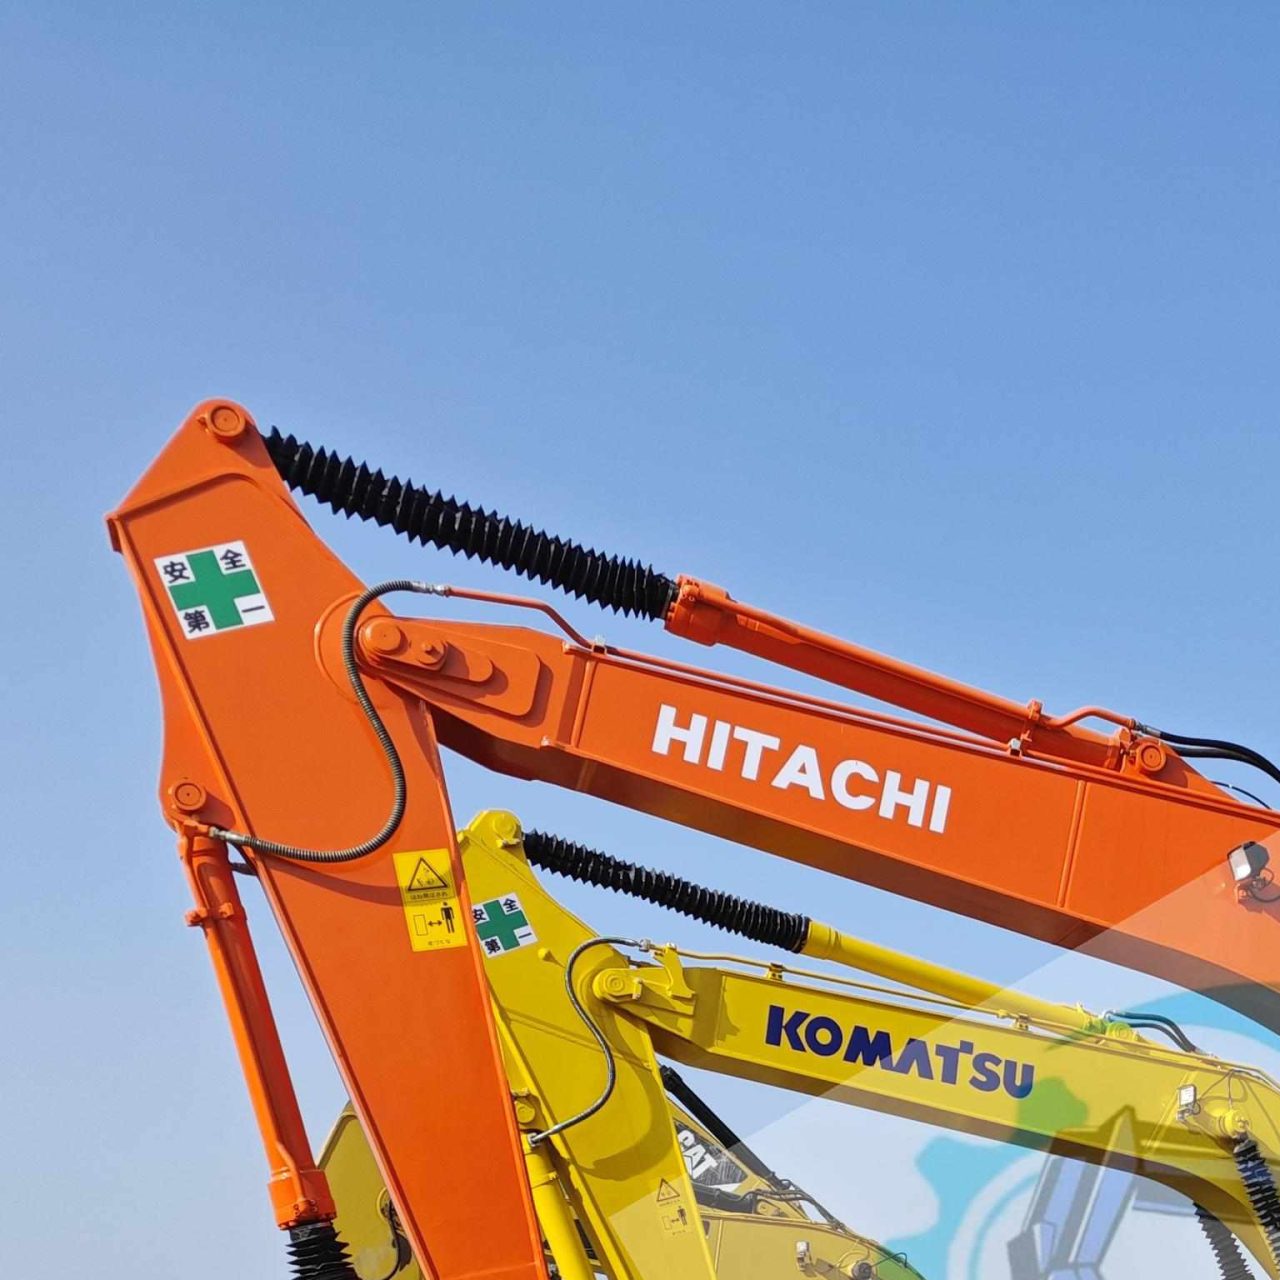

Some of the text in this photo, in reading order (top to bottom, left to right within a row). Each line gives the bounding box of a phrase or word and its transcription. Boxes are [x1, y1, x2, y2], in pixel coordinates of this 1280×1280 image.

[162, 548, 247, 584] 安 全
[183, 609, 210, 634] 第
[652, 703, 952, 834] HITACHI
[502, 897, 519, 913] 全
[765, 1004, 1035, 1099] KOMATSU
